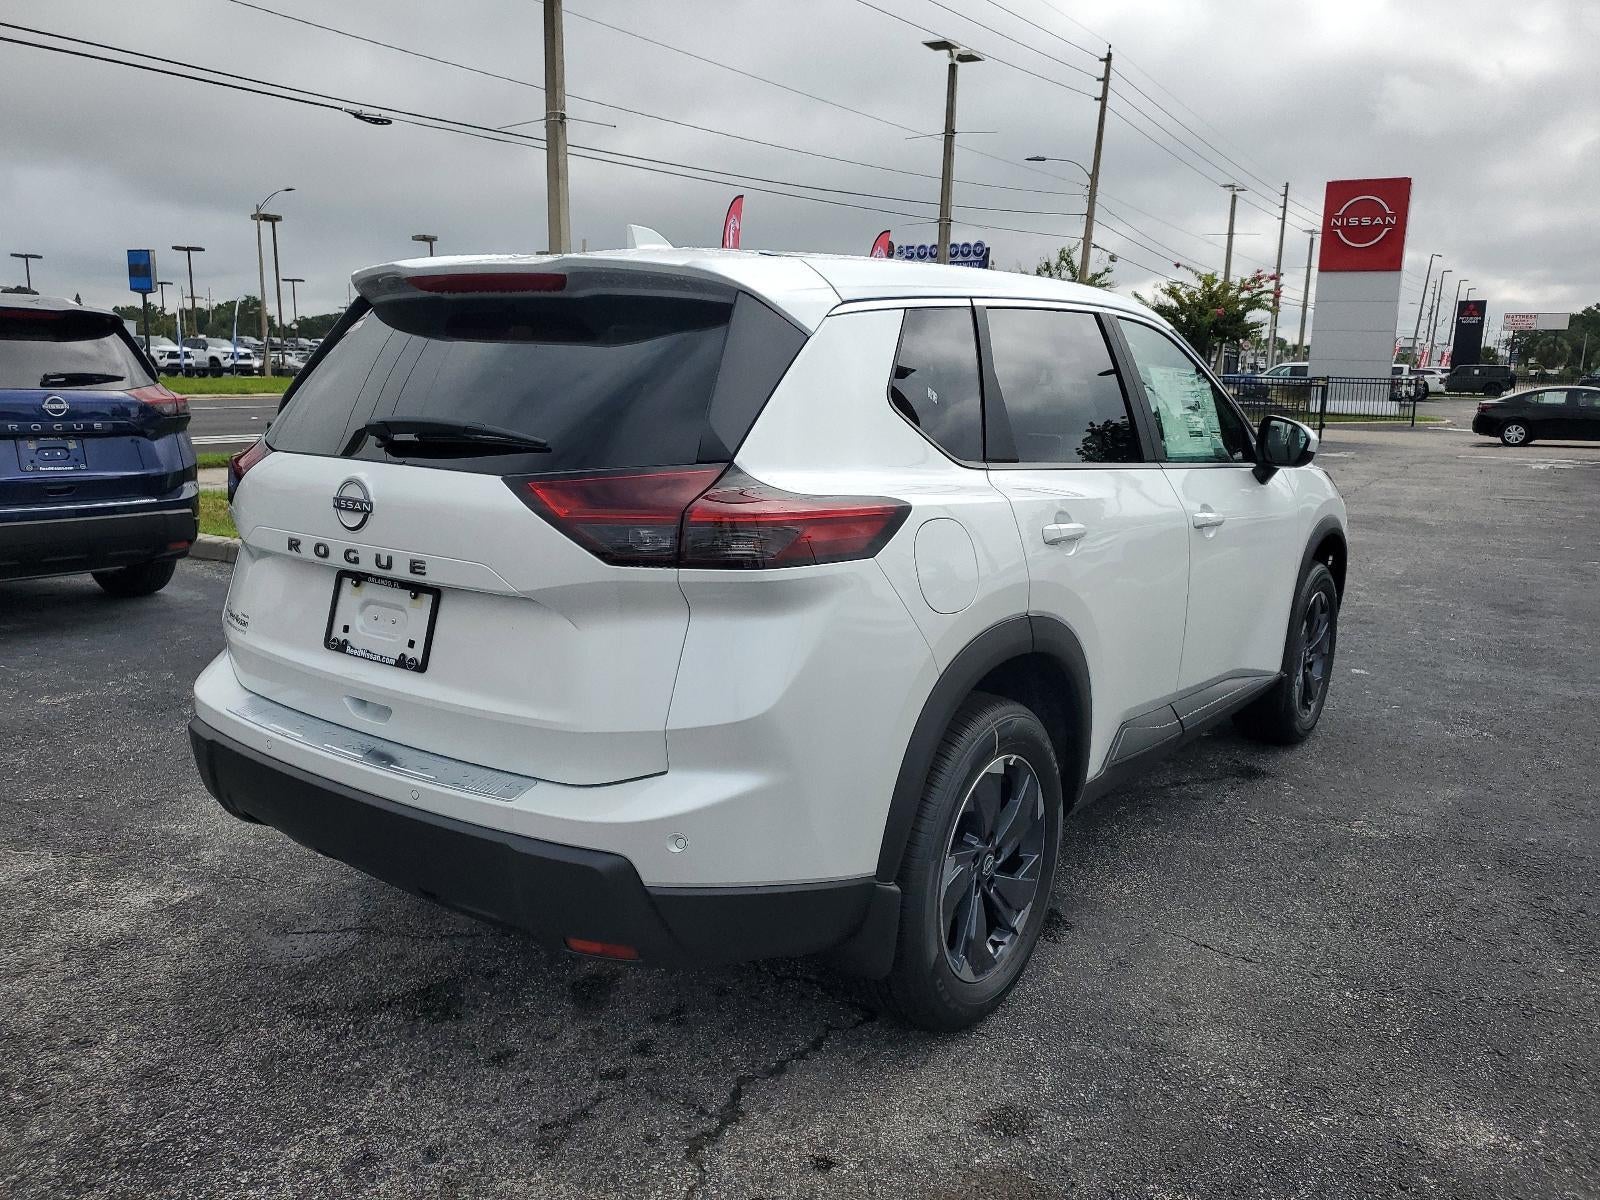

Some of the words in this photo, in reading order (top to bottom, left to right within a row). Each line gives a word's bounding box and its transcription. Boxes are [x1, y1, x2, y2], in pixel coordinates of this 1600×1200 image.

[1331, 216, 1396, 226] NISSAN
[8, 423, 103, 431] ROGUE
[333, 498, 371, 512] NISSAN
[287, 536, 427, 576] ROGUE
[346, 645, 395, 665] ReedNissan.com
